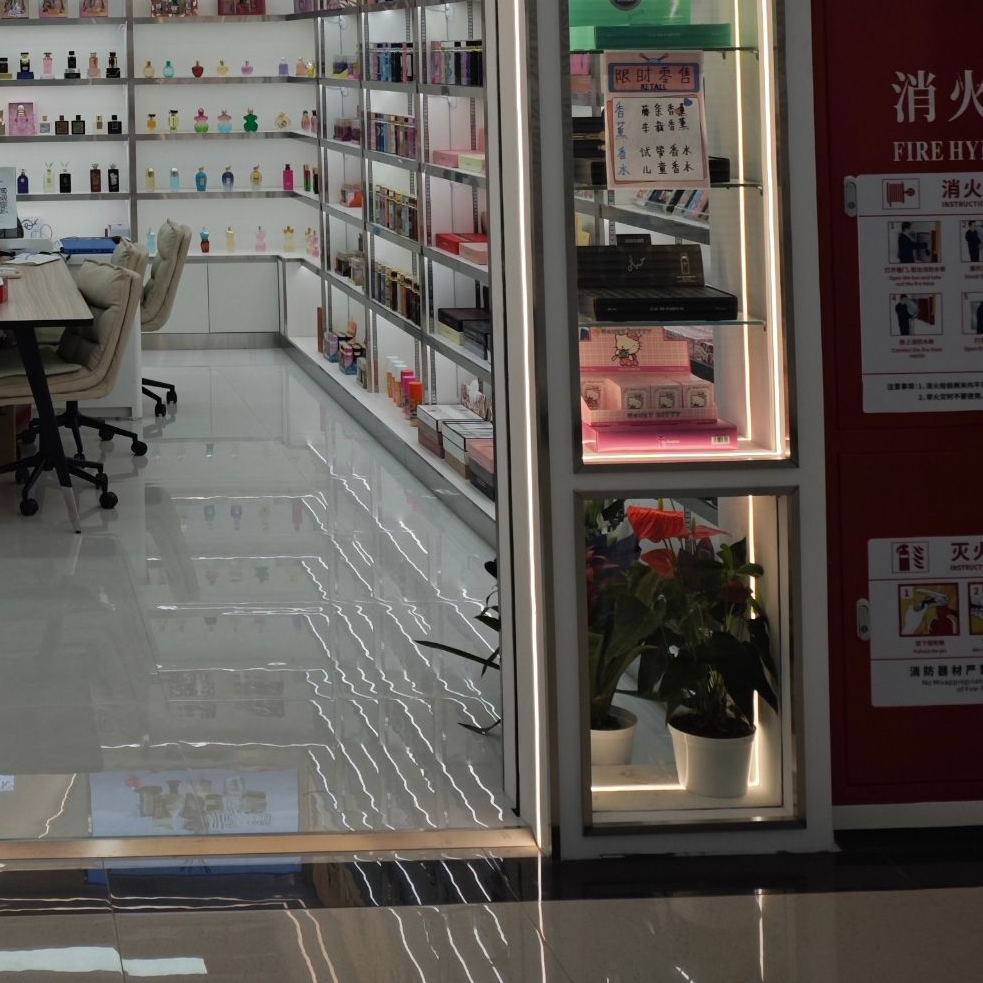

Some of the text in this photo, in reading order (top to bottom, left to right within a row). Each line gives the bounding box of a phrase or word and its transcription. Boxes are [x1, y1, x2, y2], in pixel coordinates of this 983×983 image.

[615, 66, 690, 84] 限时零售
[892, 140, 983, 161] FIRE HY
[942, 179, 983, 199] 消火
